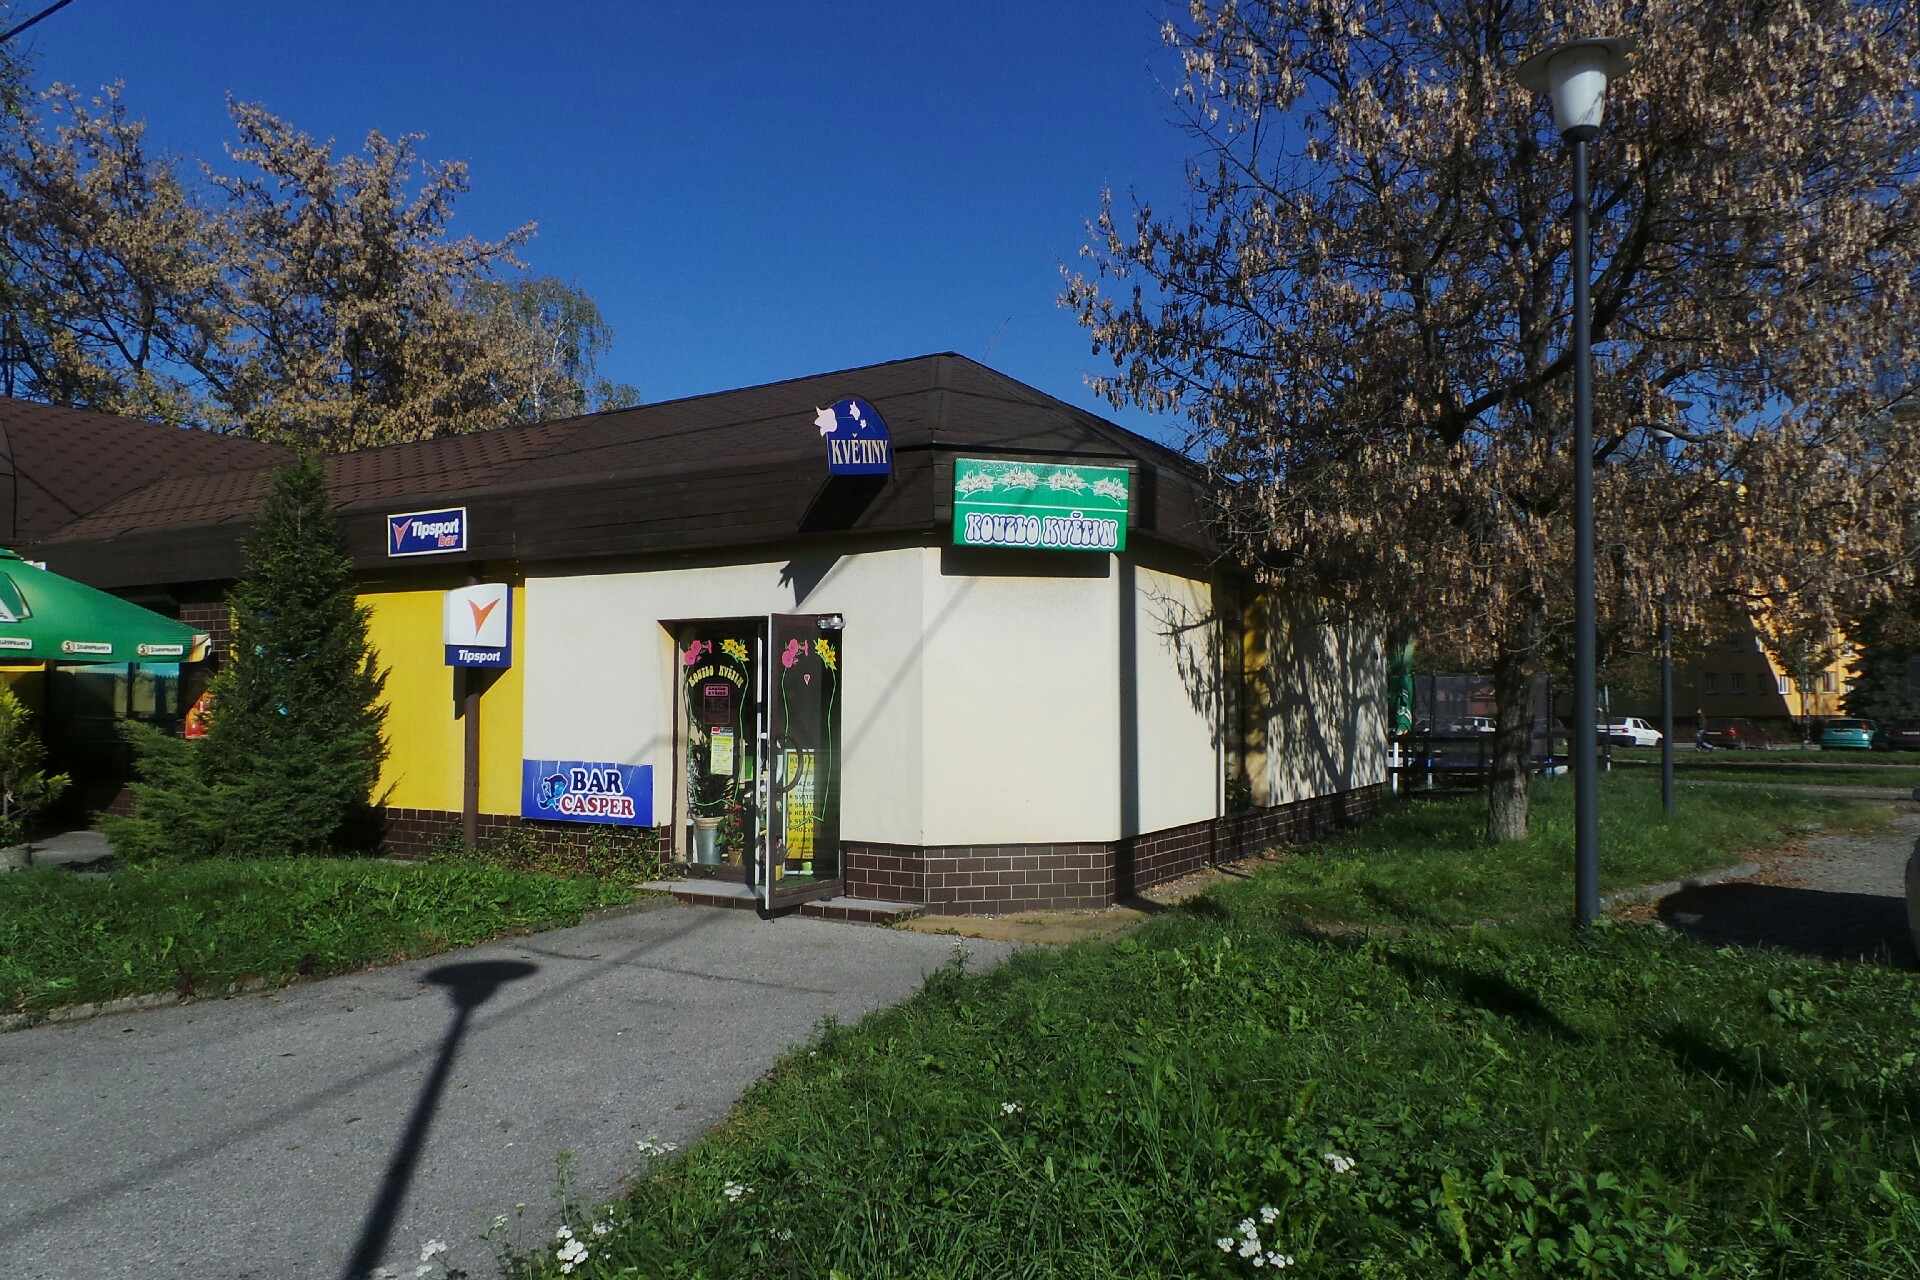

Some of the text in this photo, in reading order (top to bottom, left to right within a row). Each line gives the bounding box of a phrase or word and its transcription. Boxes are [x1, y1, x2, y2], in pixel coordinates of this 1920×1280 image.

[831, 433, 888, 465] KVĚTINY
[411, 518, 460, 540] Tipsport
[437, 533, 459, 547] bar
[966, 511, 1118, 547] KOUZLO KVĚTIN
[458, 649, 501, 664] Tipsport
[571, 769, 622, 795] BAR
[560, 794, 635, 817] CASPER
